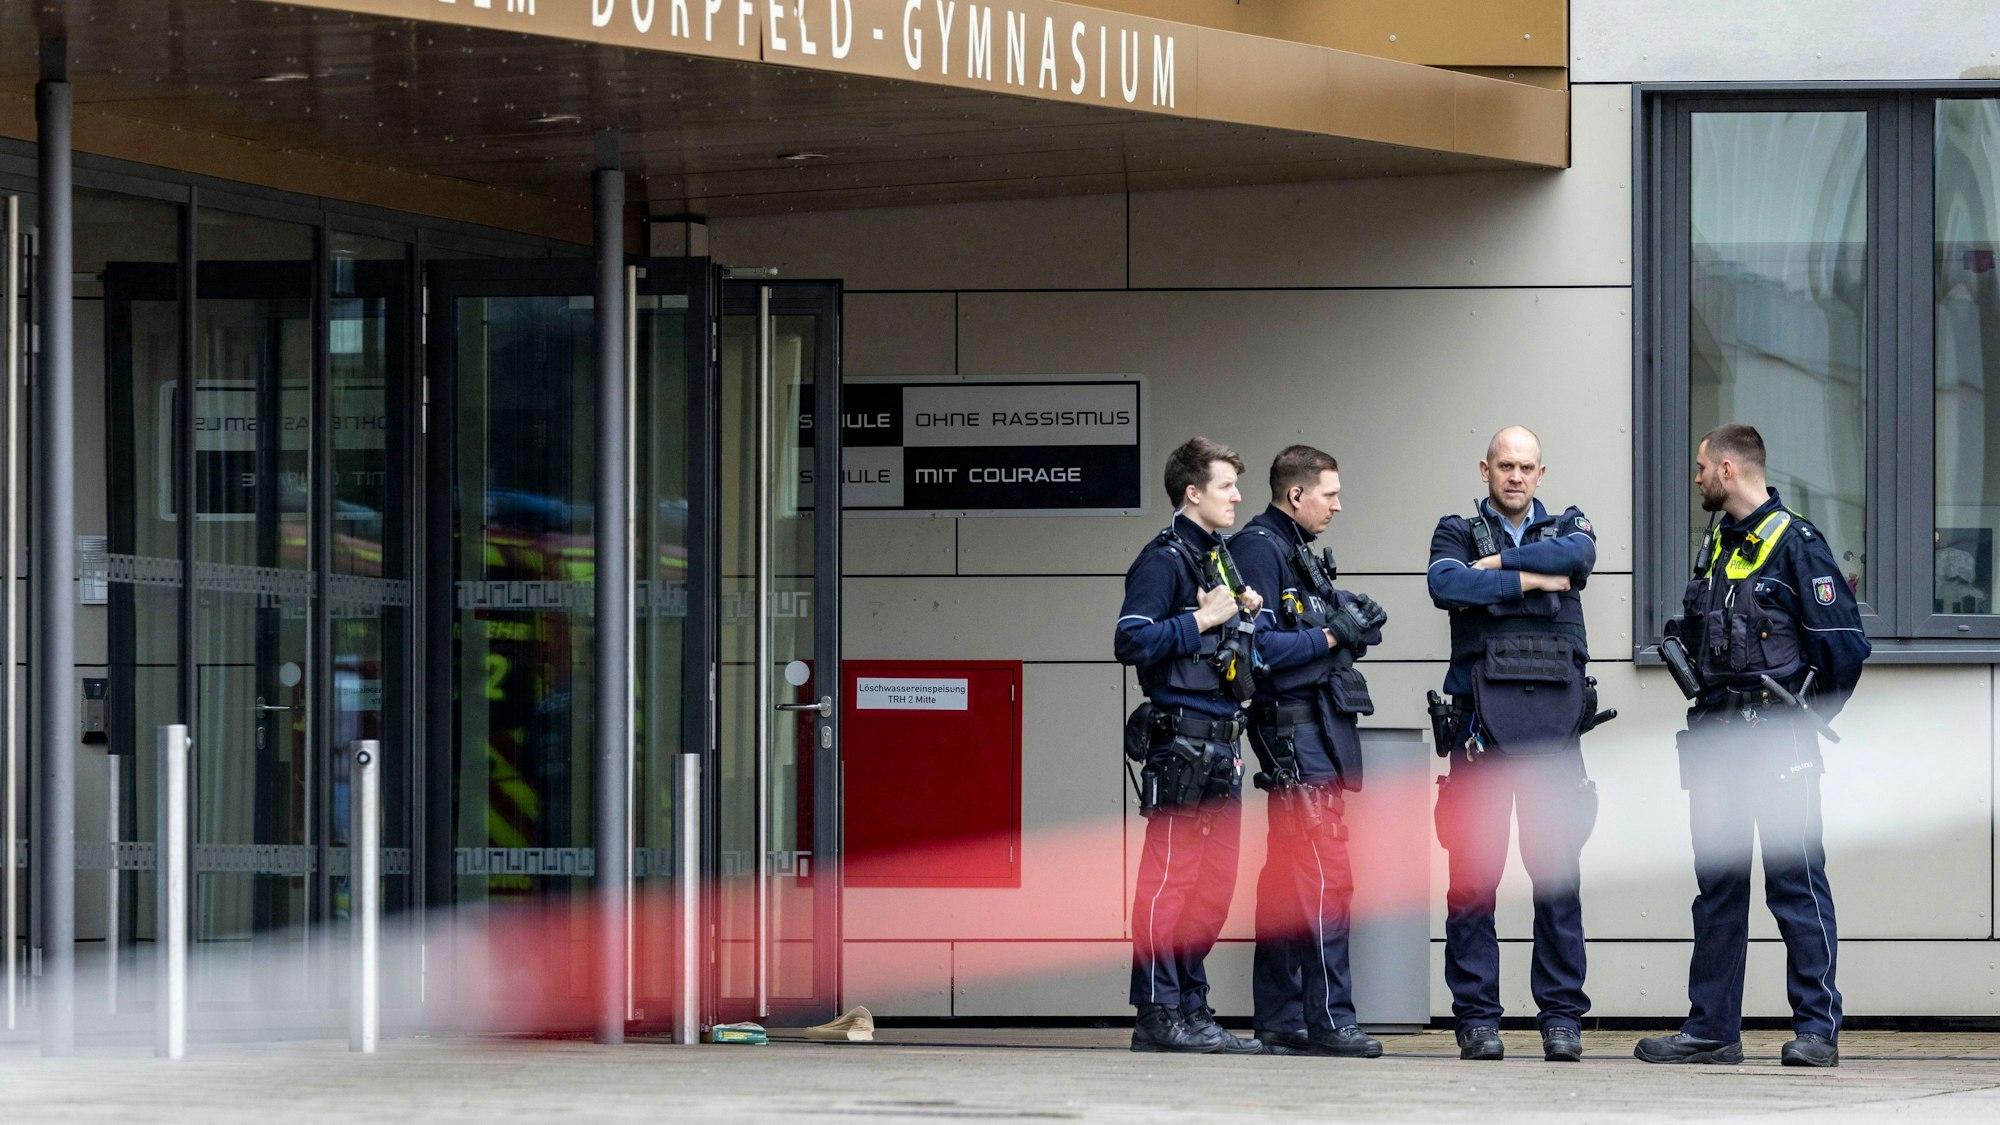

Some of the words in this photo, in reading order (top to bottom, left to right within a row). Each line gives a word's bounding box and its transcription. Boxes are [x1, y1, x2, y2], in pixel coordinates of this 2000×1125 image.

[799, 413, 891, 429] SULE
[915, 412, 980, 428] OHNE
[992, 410, 1131, 427] RASSISMUS
[799, 469, 891, 485] SULE
[915, 468, 958, 484] MIT
[968, 467, 1082, 484] COURAGE
[859, 683, 966, 695] Löschwassereinspeisung
[888, 695, 906, 703] TRH
[908, 695, 913, 704] 2
[915, 695, 936, 704] Mitte
